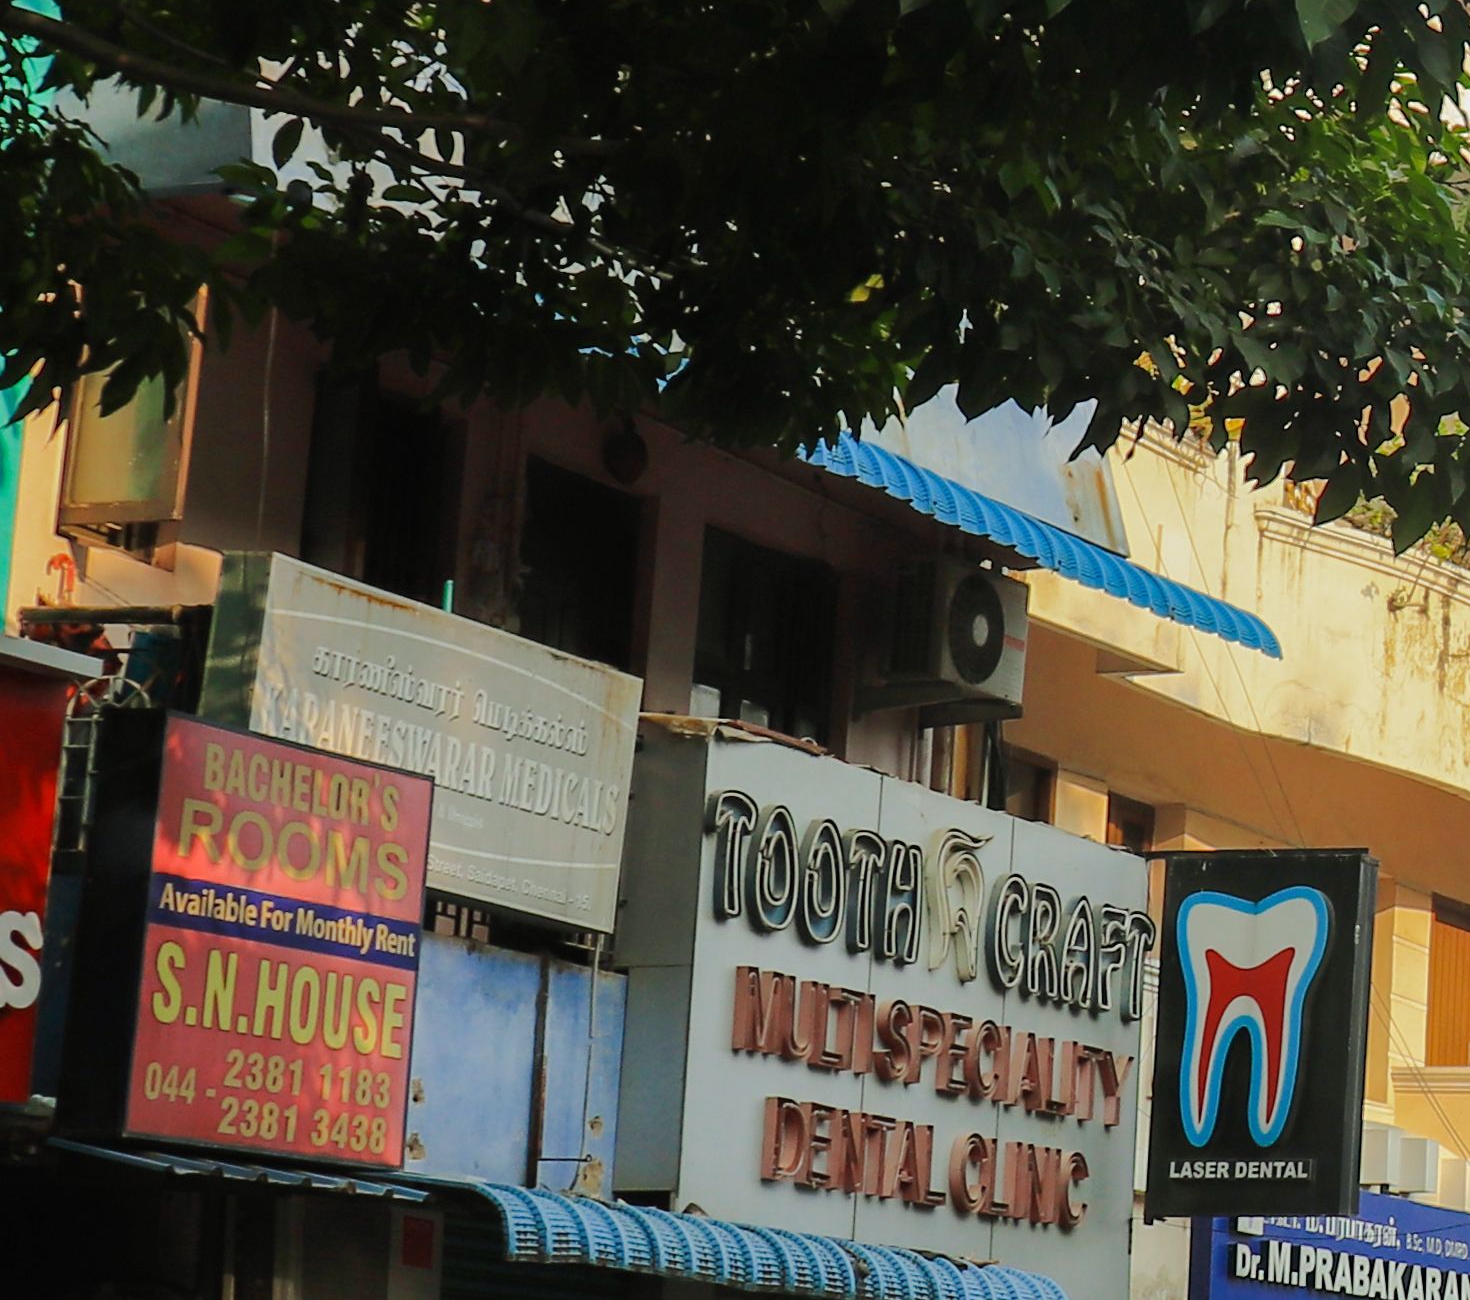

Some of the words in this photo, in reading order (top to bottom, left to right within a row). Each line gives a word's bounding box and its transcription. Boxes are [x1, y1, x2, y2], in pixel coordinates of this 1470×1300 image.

[203, 744, 399, 832] BACHELOR'S
[265, 685, 496, 800] KARANEESWARAR
[499, 753, 620, 835] MEDICALS
[178, 799, 410, 900] ROOMS
[160, 883, 256, 930] Available
[260, 902, 291, 934] For
[296, 908, 373, 956] Monthly
[375, 926, 416, 958] Rent
[706, 790, 922, 965] TOOTH
[987, 873, 1156, 1021] CRAFT
[145, 1062, 196, 1103] 044
[224, 1050, 303, 1095] 2381
[319, 1064, 392, 1109] 1183
[732, 966, 1134, 1129] MULTISPECIALITY
[218, 1097, 297, 1142] 2381
[311, 1109, 387, 1155] 3438
[761, 1096, 945, 1207] DENTAL
[952, 1133, 1088, 1230] CLINIC
[1170, 1161, 1229, 1179] LASER
[1234, 1162, 1308, 1180] DENTAL
